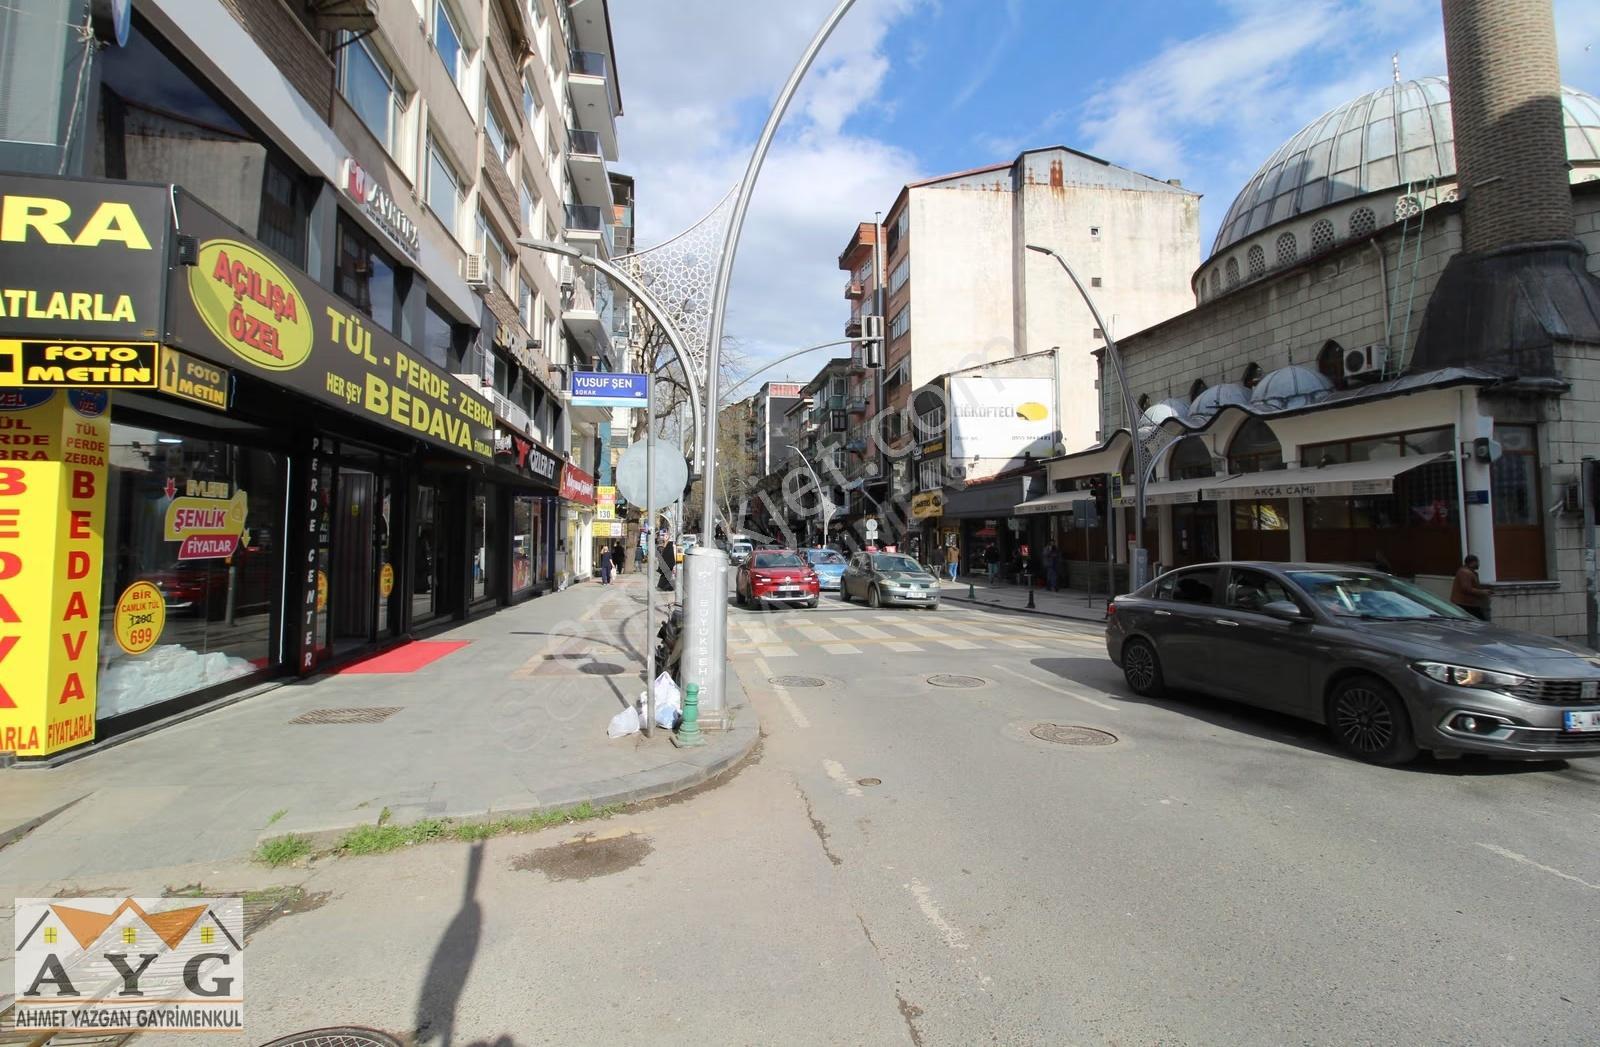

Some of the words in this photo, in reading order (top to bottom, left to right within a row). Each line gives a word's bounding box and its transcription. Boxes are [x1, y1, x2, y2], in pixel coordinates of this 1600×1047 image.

[1, 196, 152, 250] RA
[213, 250, 298, 325] AÇILIŞA
[0, 289, 136, 322] TLARLA
[228, 301, 284, 360] ÖZEL
[45, 347, 138, 361] FOTO
[28, 363, 151, 382] METİN
[187, 363, 221, 383] FOTO
[326, 306, 377, 365] TÜL
[396, 351, 449, 405] PERDE
[459, 392, 493, 430] ZEBRA
[179, 379, 224, 405] METİN
[575, 377, 609, 387] YUSUF
[611, 378, 632, 390] ŞEN
[326, 372, 344, 397] HER
[346, 381, 362, 405] ŞEY
[365, 372, 473, 451] BEDAVA
[75, 423, 98, 436] TÜL
[66, 437, 105, 452] PERDE
[64, 452, 104, 467] ZEBRA
[308, 437, 319, 533] PERDE
[174, 507, 227, 532] ŞENLİK
[187, 536, 231, 553] FİYATLAR
[59, 470, 95, 704] BEDAVA
[132, 589, 151, 600] BİR
[304, 548, 316, 667] CENTER
[130, 628, 152, 645] 699
[47, 713, 92, 749] FİYATLARLA
